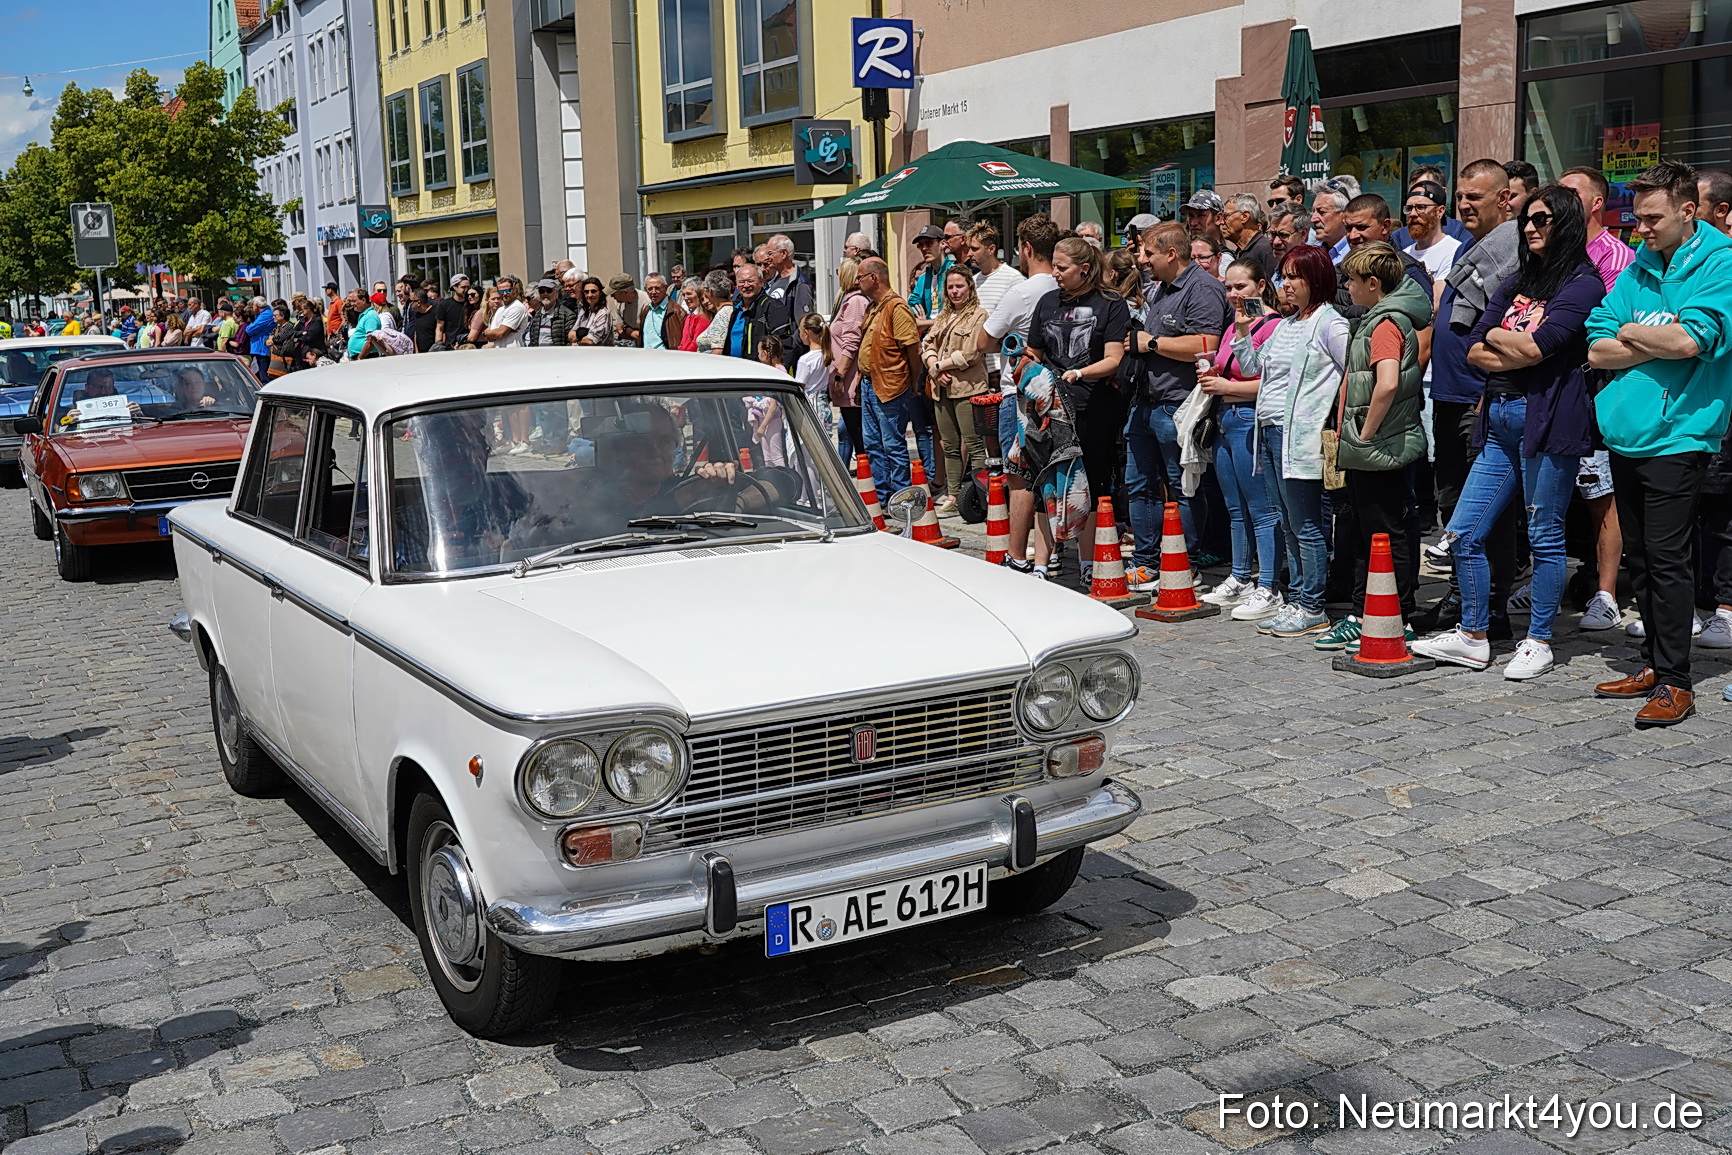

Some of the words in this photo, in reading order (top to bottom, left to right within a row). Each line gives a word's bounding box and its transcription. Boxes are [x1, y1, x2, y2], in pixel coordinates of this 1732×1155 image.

[857, 26, 911, 79] R.
[920, 107, 941, 120] Unterer
[942, 102, 959, 116] Markt
[960, 100, 968, 113] 15
[818, 137, 838, 163] G2
[982, 181, 1060, 192] Lammsbräu
[986, 177, 1042, 186] Neumarkter
[102, 400, 119, 408] 367
[857, 731, 873, 759] FIAT
[791, 904, 815, 946] R
[842, 889, 889, 936] AE
[896, 867, 984, 922] 612H
[774, 934, 783, 946] D
